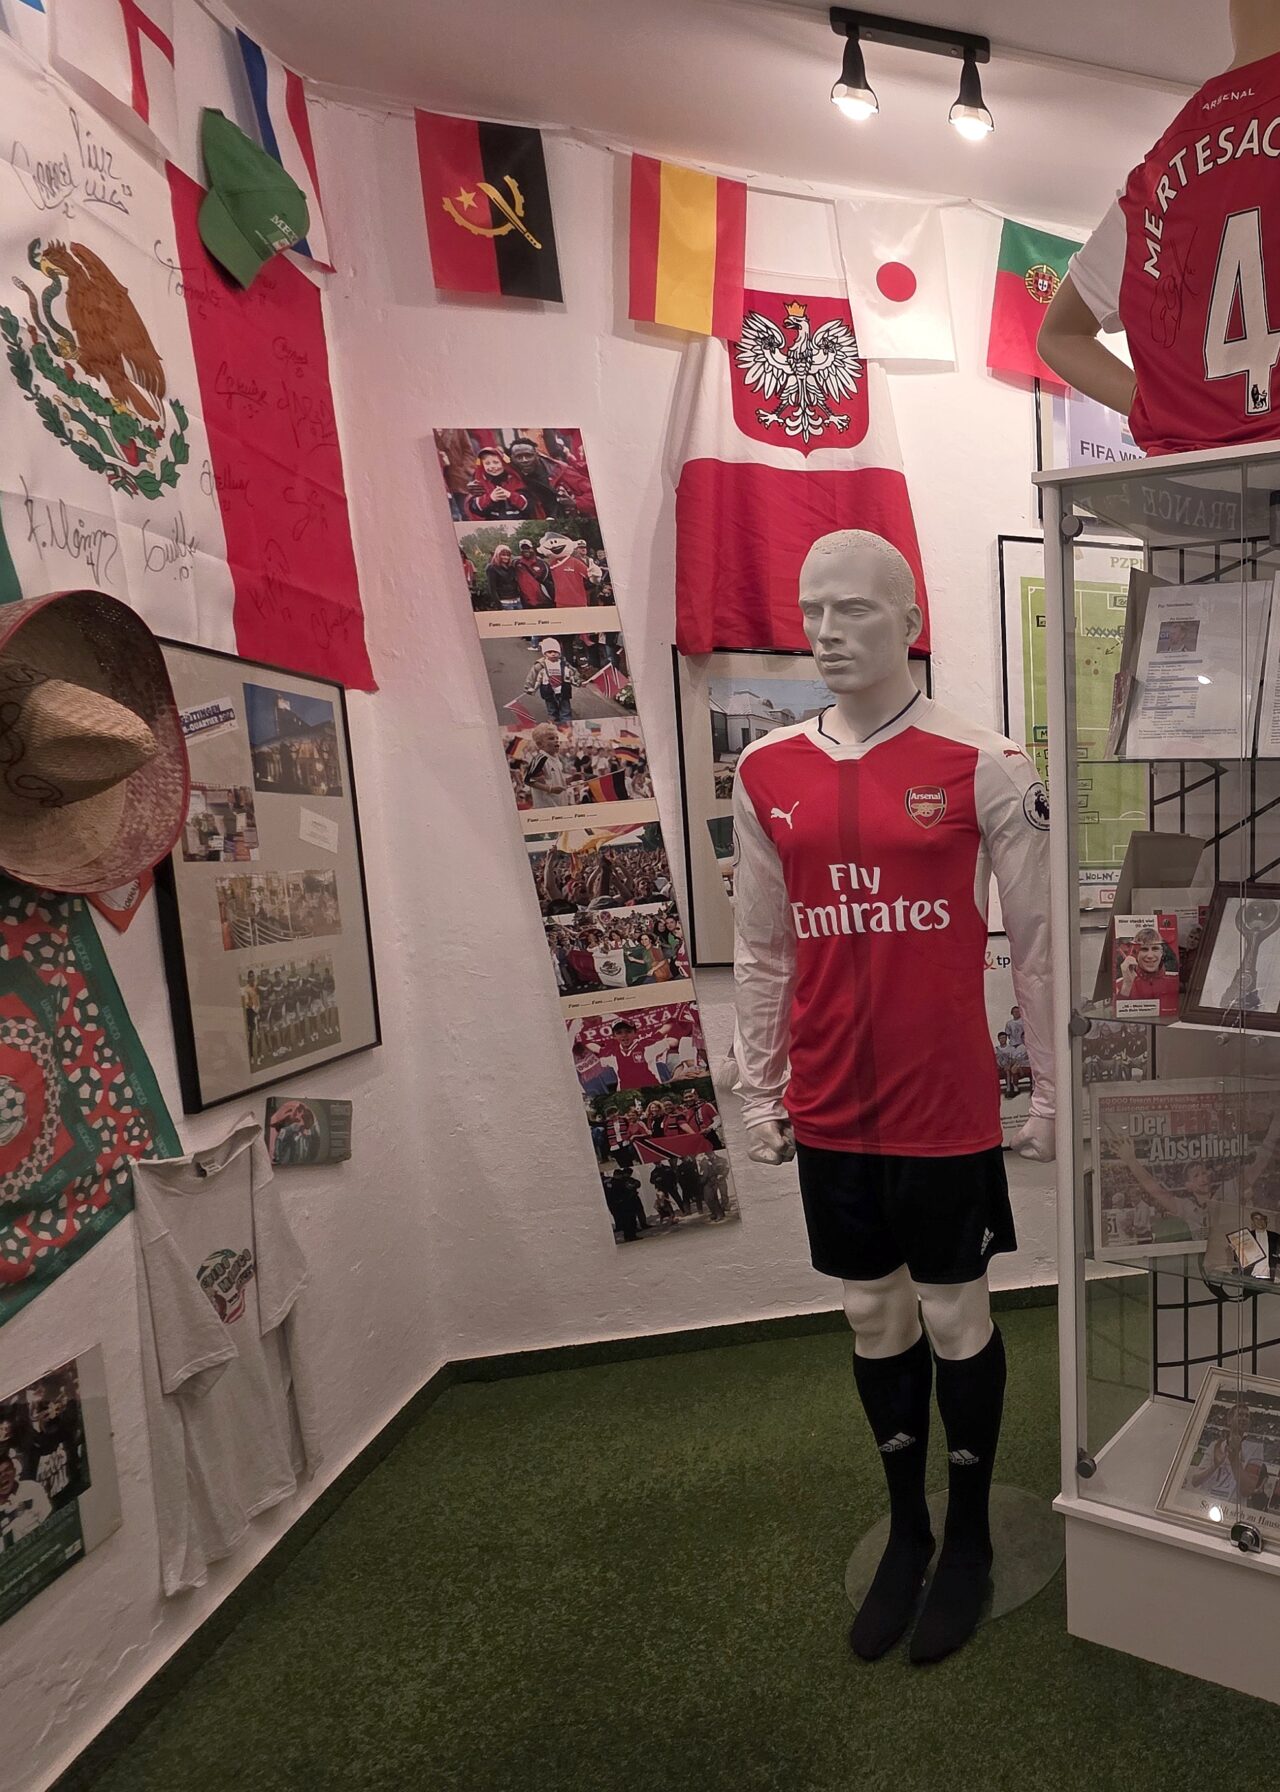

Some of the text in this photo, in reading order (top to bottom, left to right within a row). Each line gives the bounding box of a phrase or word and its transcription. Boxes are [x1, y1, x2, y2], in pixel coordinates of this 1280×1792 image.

[1202, 88, 1255, 112] ARSENAL
[1080, 440, 1116, 463] FIFA
[911, 792, 941, 801] Arsenal
[828, 863, 881, 894] Fly
[790, 894, 951, 939] Emirates
[996, 955, 1011, 968] tp
[583, 1010, 673, 1041] POSKA
[1129, 1113, 1167, 1137] Der
[1149, 1133, 1250, 1163] Abschied!
